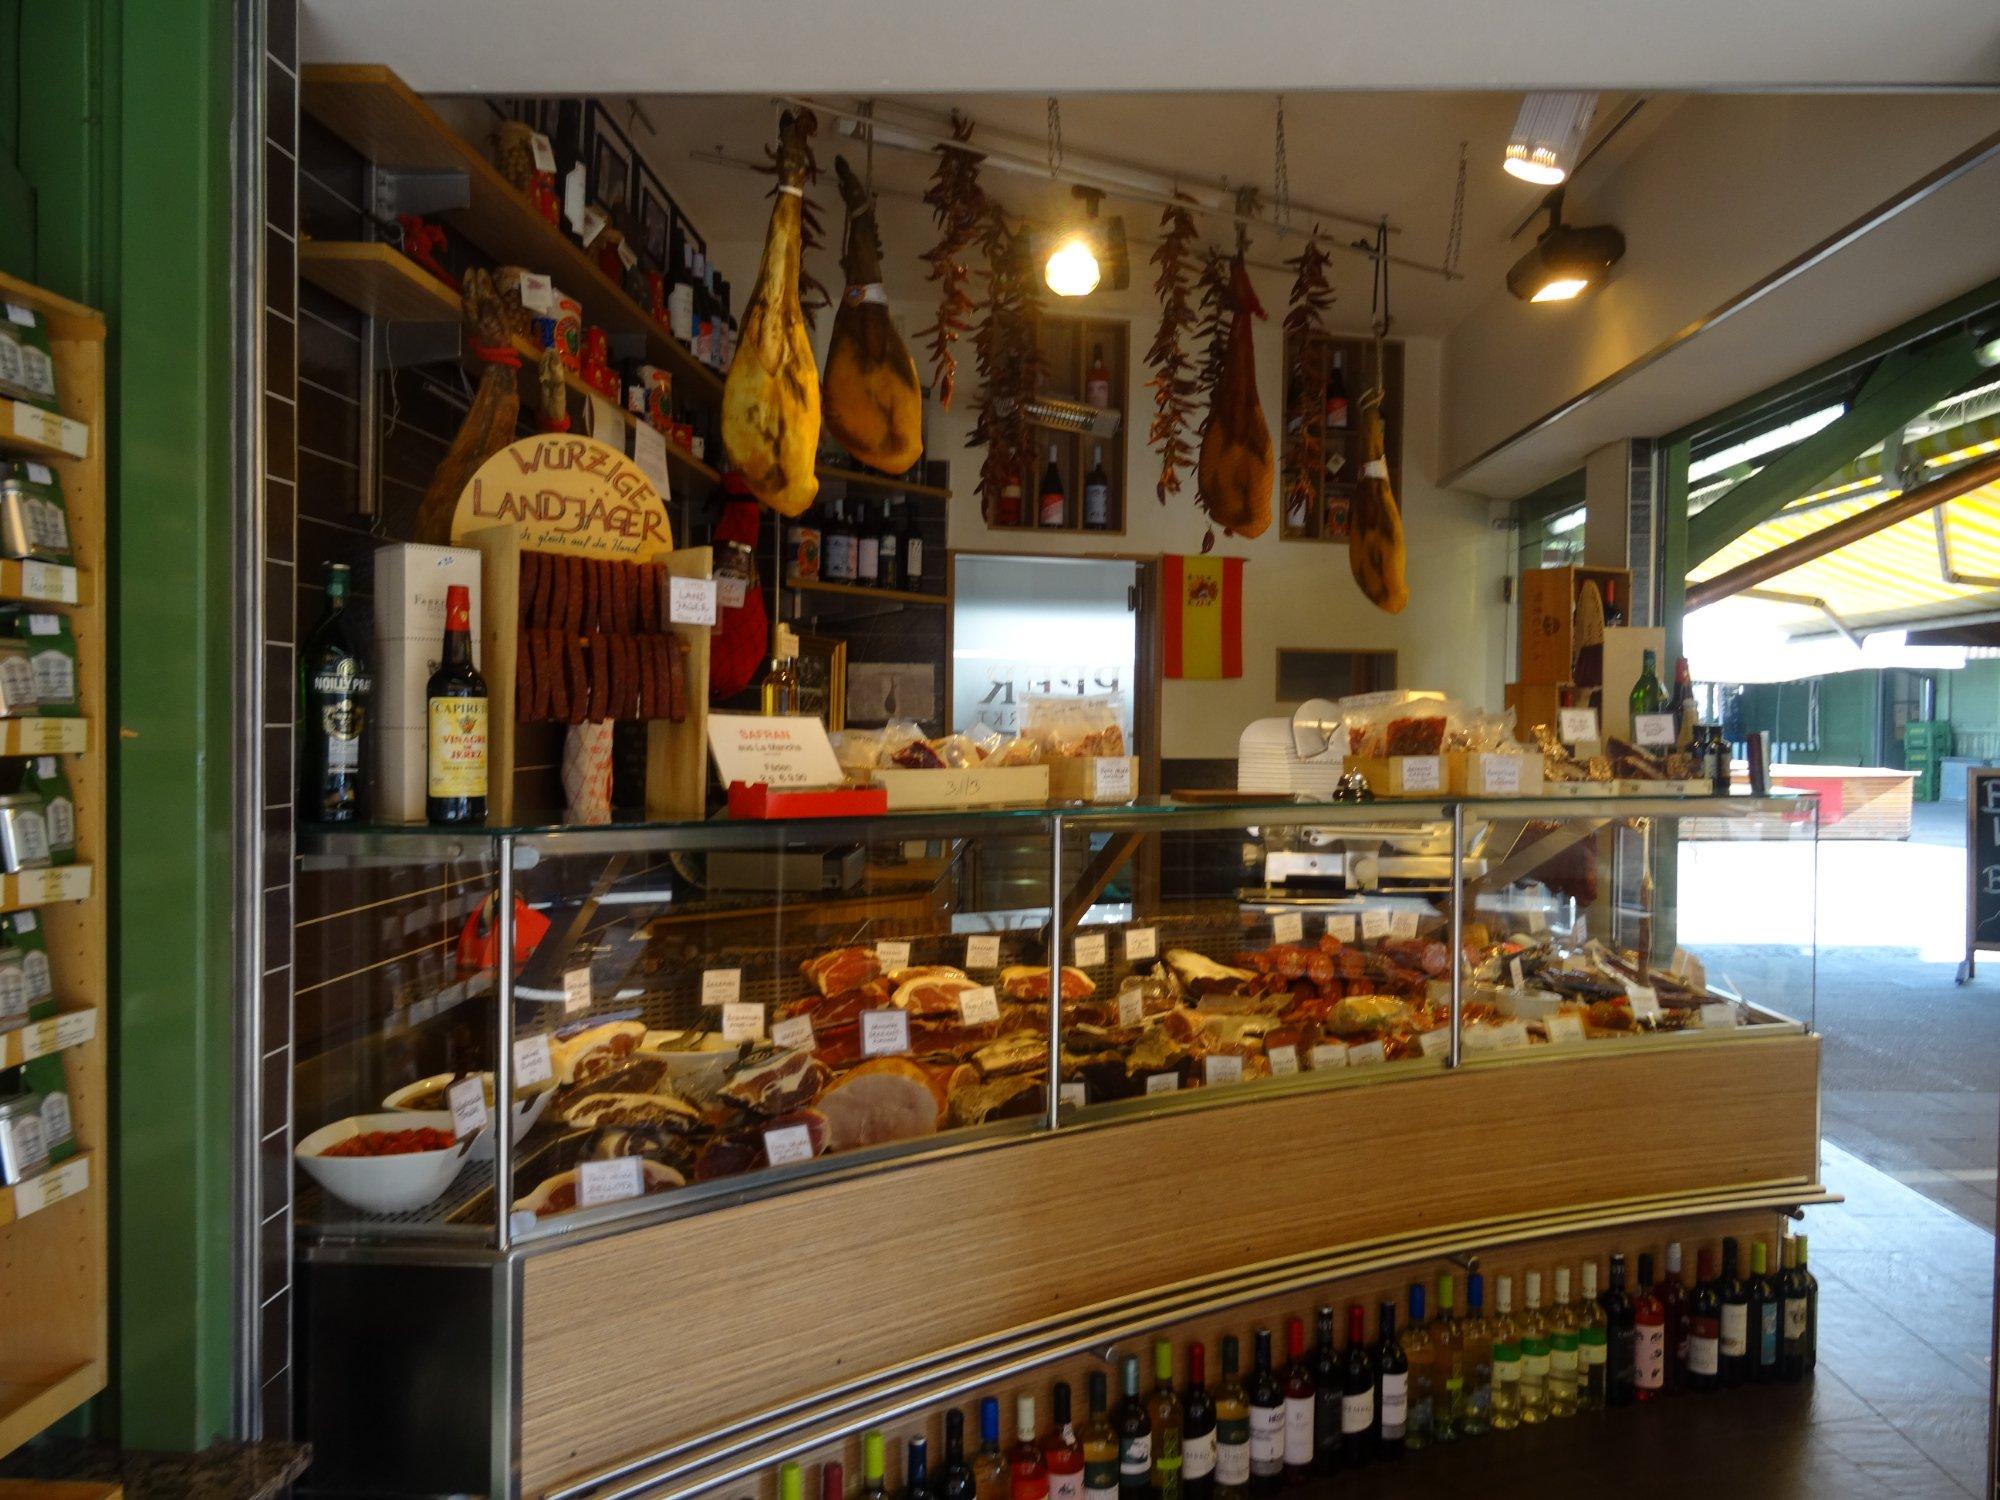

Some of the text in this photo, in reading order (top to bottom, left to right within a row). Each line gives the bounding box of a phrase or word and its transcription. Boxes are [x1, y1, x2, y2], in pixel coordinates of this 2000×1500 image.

[508, 440, 656, 514] WÜRZIGE
[473, 478, 666, 544] LANDJÄGER
[570, 535, 589, 549] auf
[592, 538, 607, 551] die
[611, 538, 641, 554] Hand
[739, 729, 791, 740] SAFRAN
